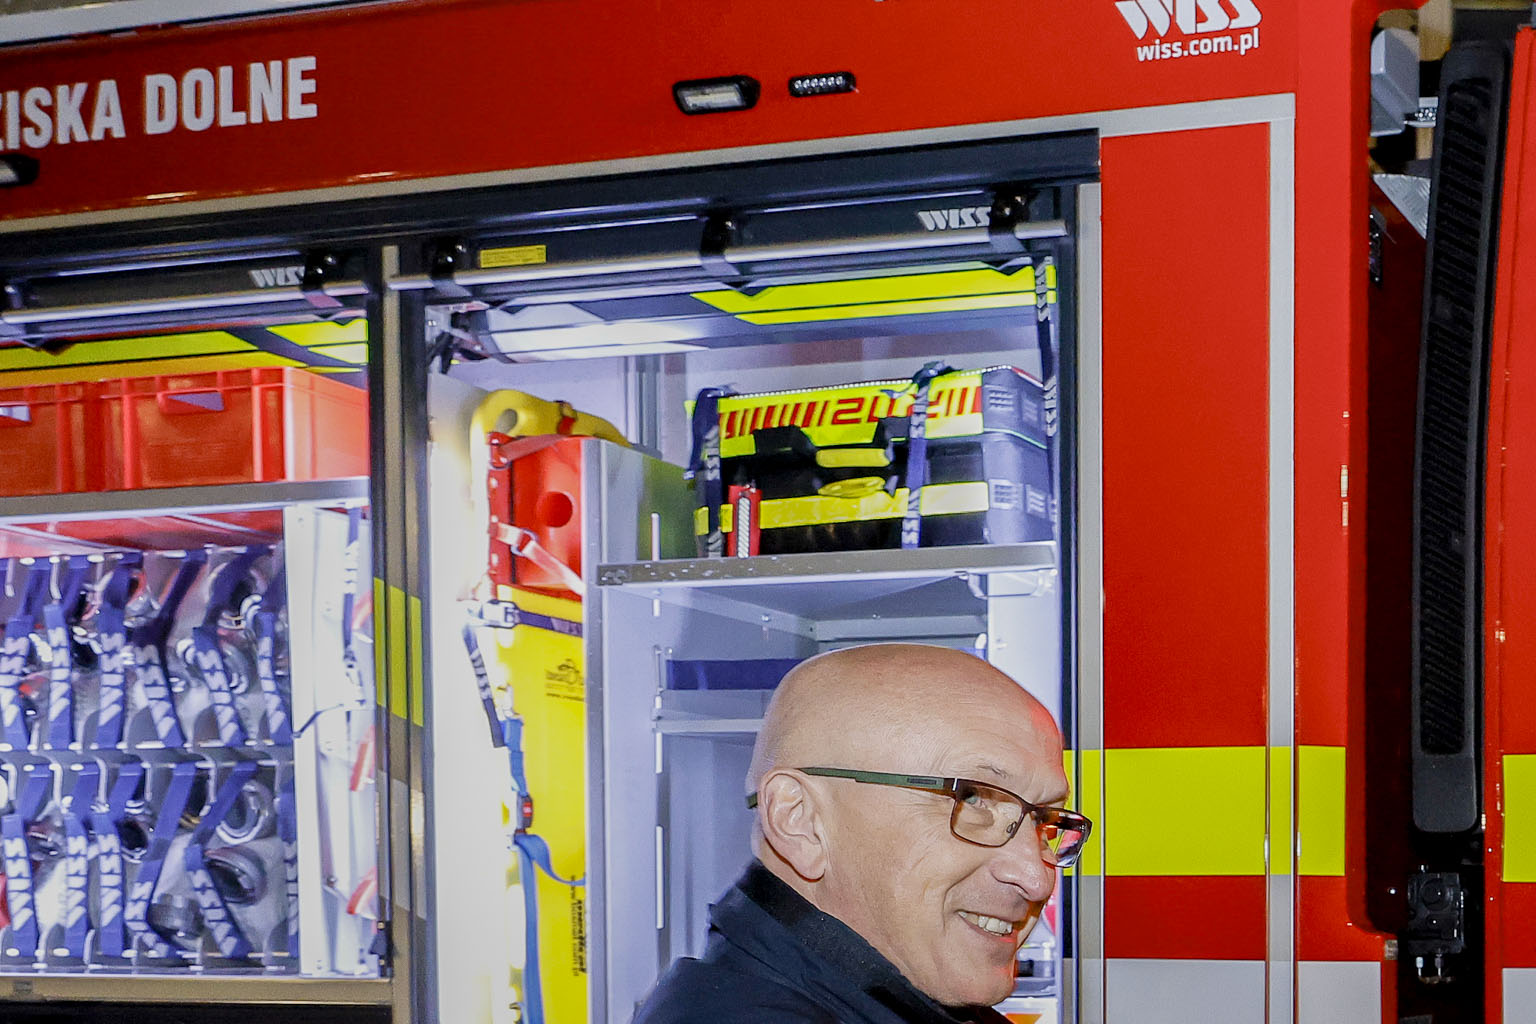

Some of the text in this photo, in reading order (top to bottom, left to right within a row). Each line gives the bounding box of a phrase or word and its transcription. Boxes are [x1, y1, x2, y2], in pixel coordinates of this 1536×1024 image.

[1115, 0, 1262, 40] WISS
[1137, 27, 1260, 62] wiss.com.pl
[0, 56, 318, 150] ISKA DOLNE
[917, 206, 992, 232] WISS
